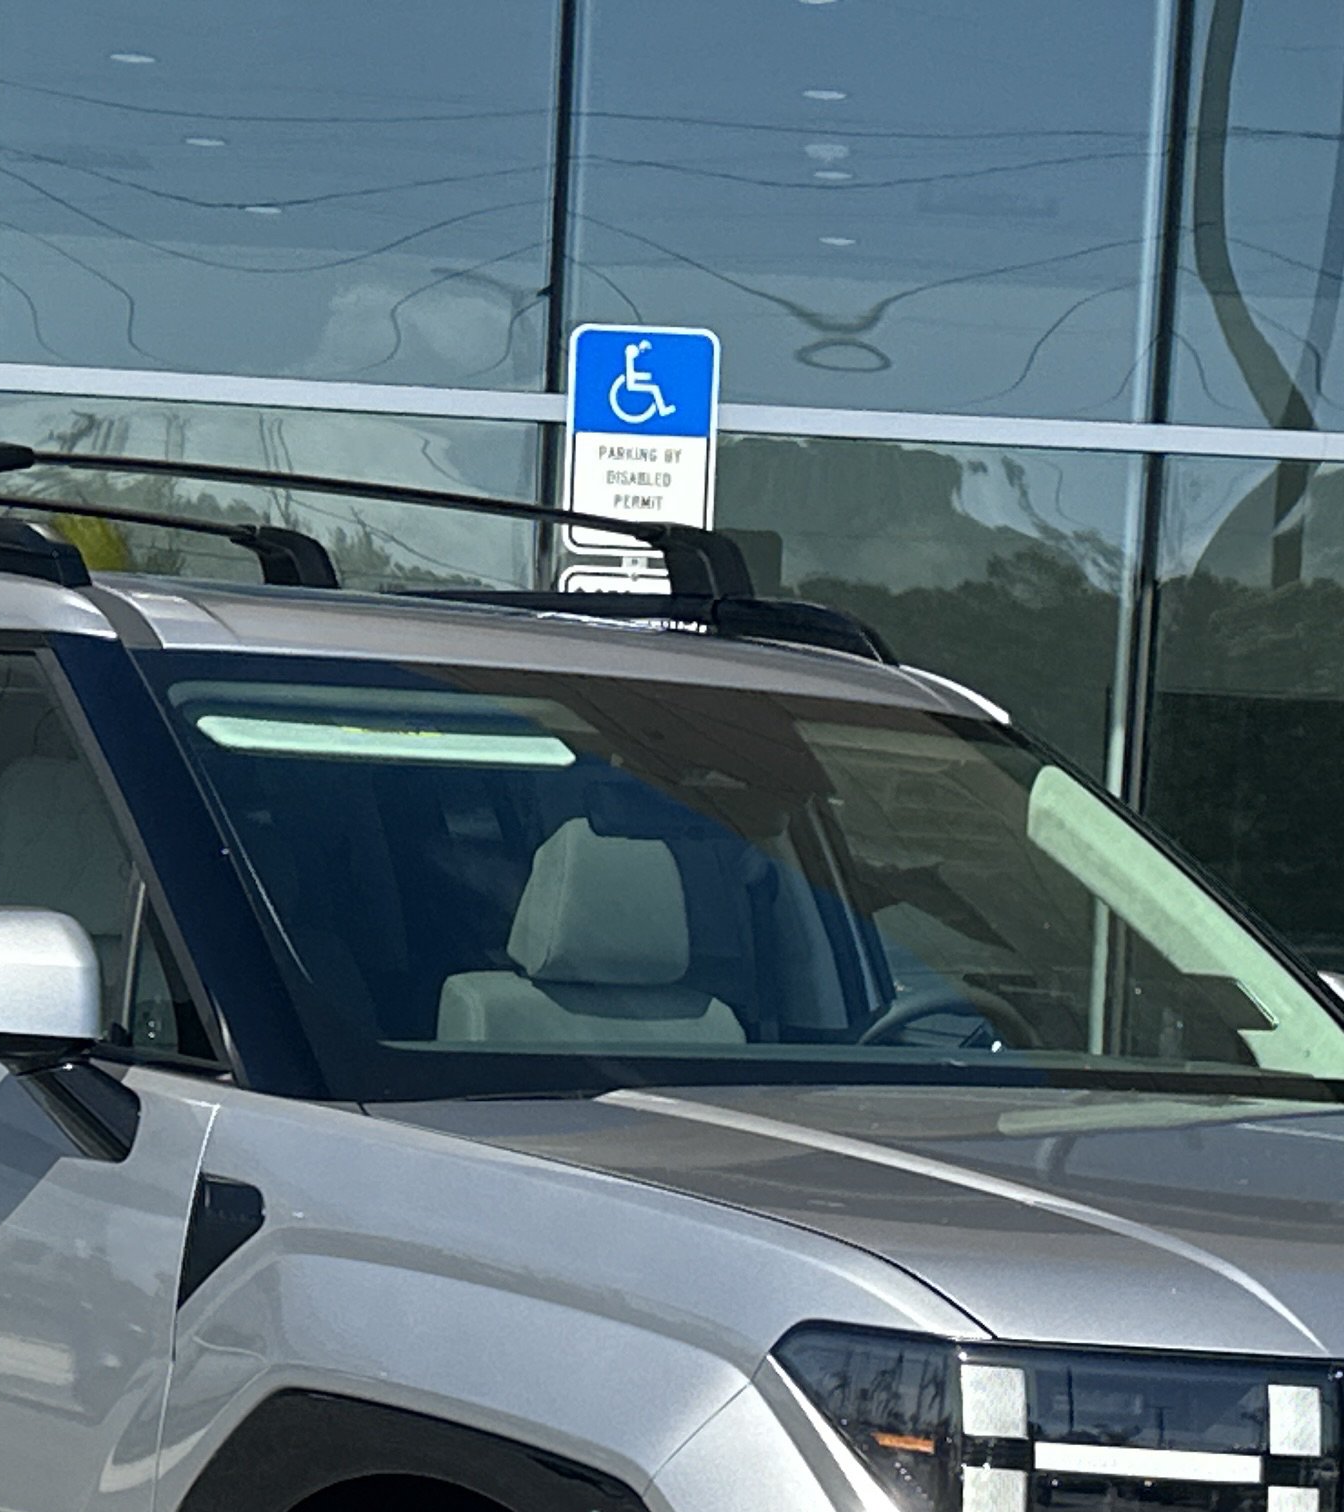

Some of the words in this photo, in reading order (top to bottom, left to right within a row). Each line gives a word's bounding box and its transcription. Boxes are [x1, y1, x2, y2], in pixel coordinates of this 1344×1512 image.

[599, 446, 657, 462] PARKING
[664, 450, 682, 463] BY
[606, 470, 672, 487] DISABLED
[614, 494, 664, 511] PERMIT
